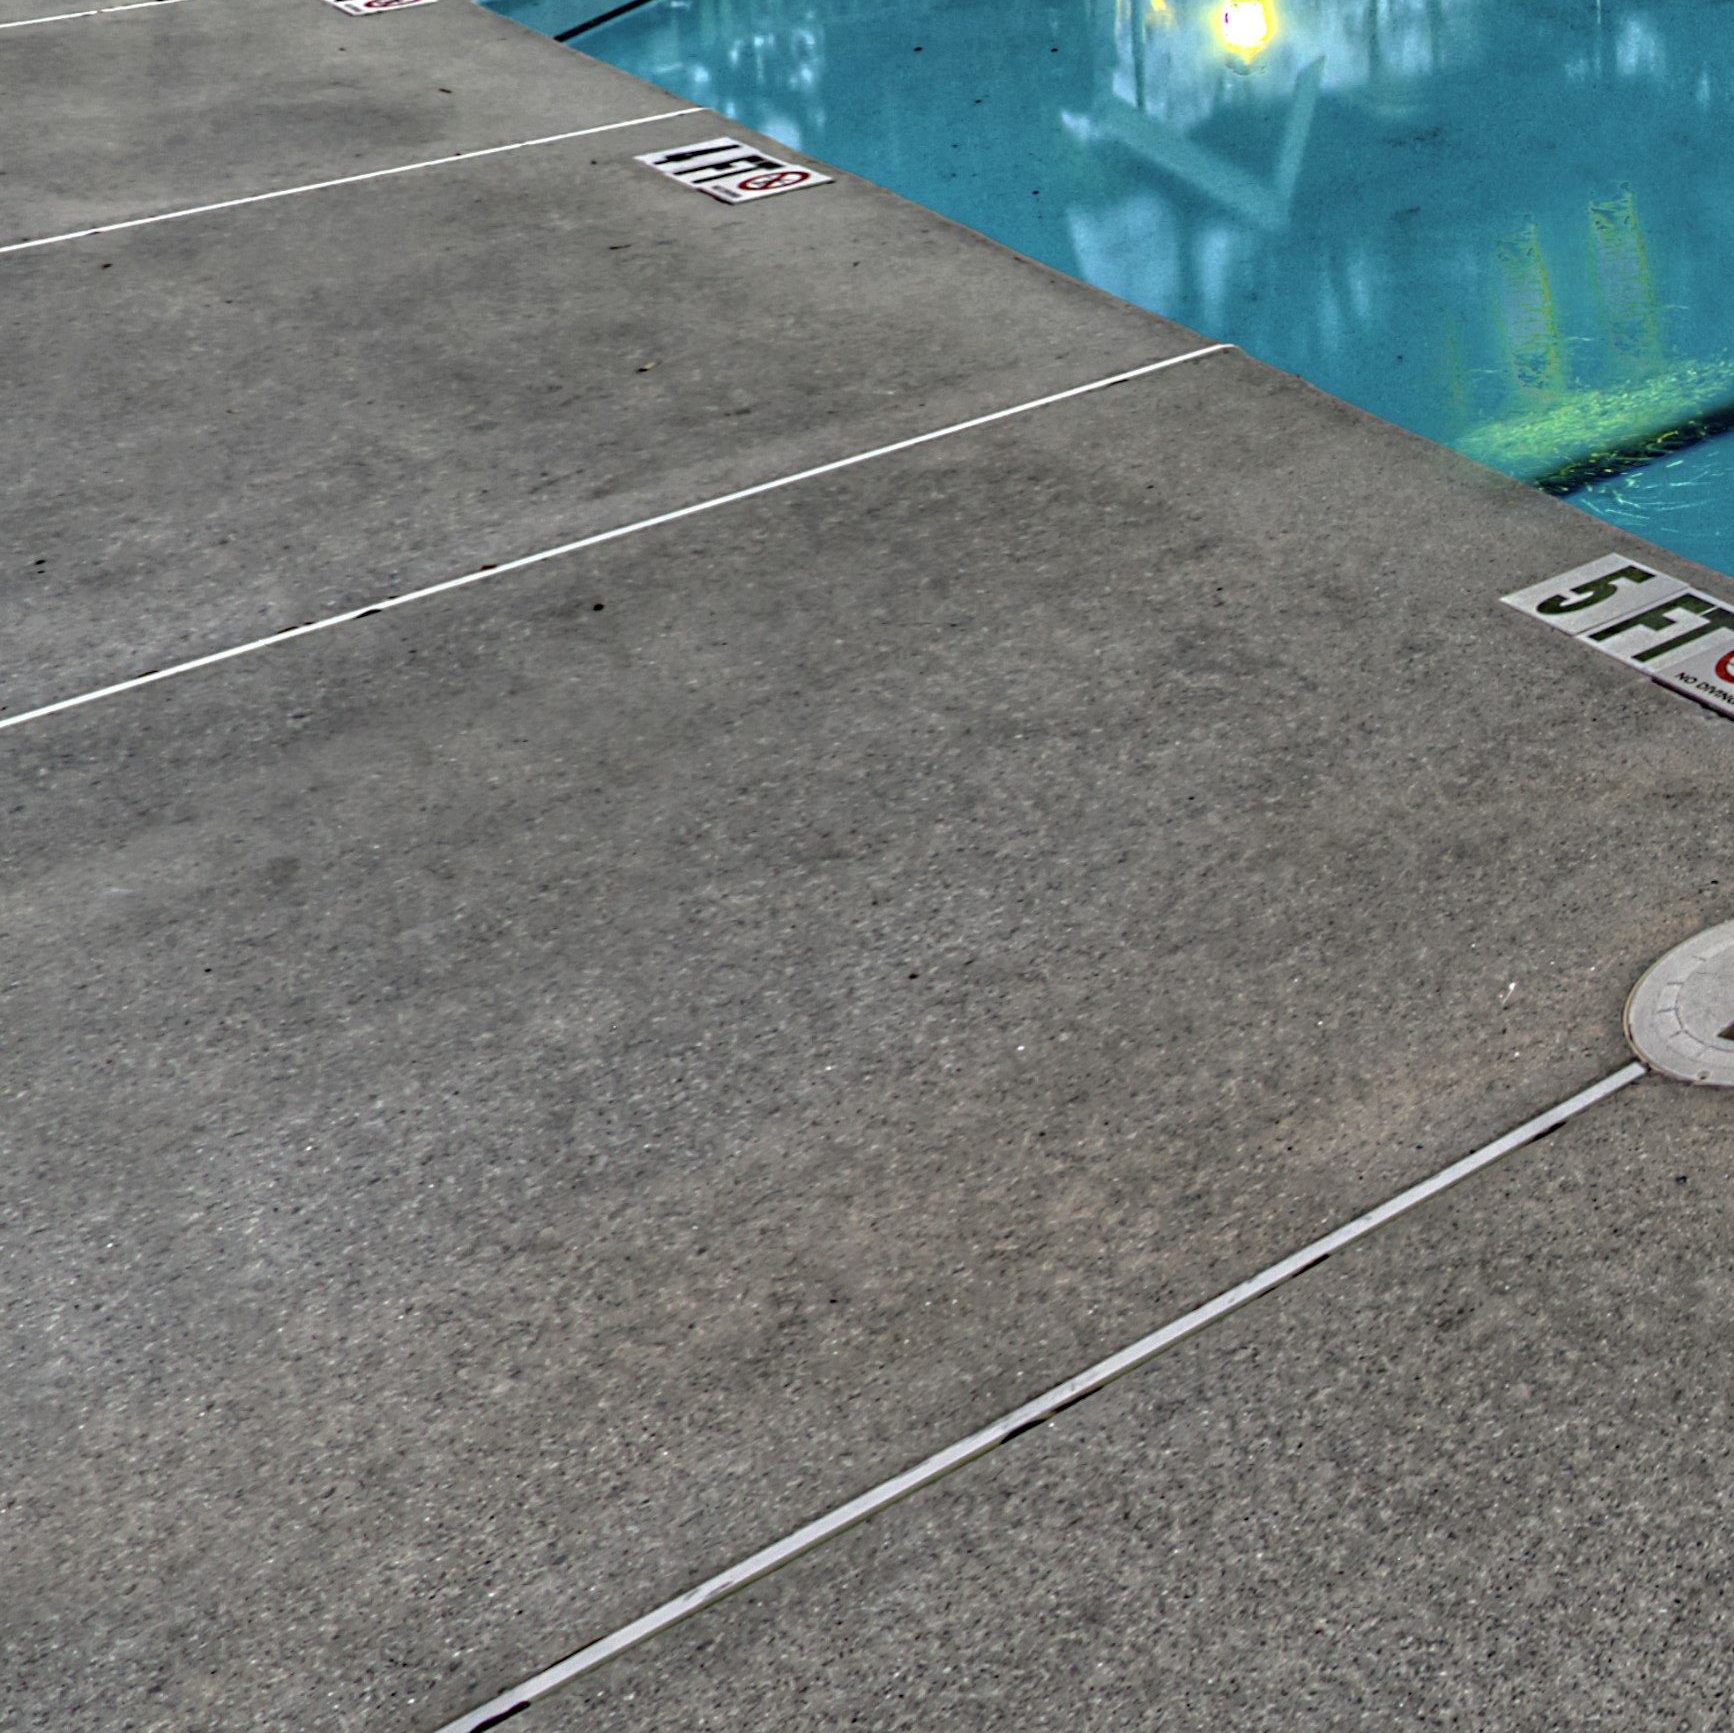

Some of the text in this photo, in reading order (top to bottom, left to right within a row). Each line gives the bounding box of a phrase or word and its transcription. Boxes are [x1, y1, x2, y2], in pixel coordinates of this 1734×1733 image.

[672, 154, 785, 184] FT
[1535, 565, 1657, 615] 5
[1674, 671, 1698, 684] NO
